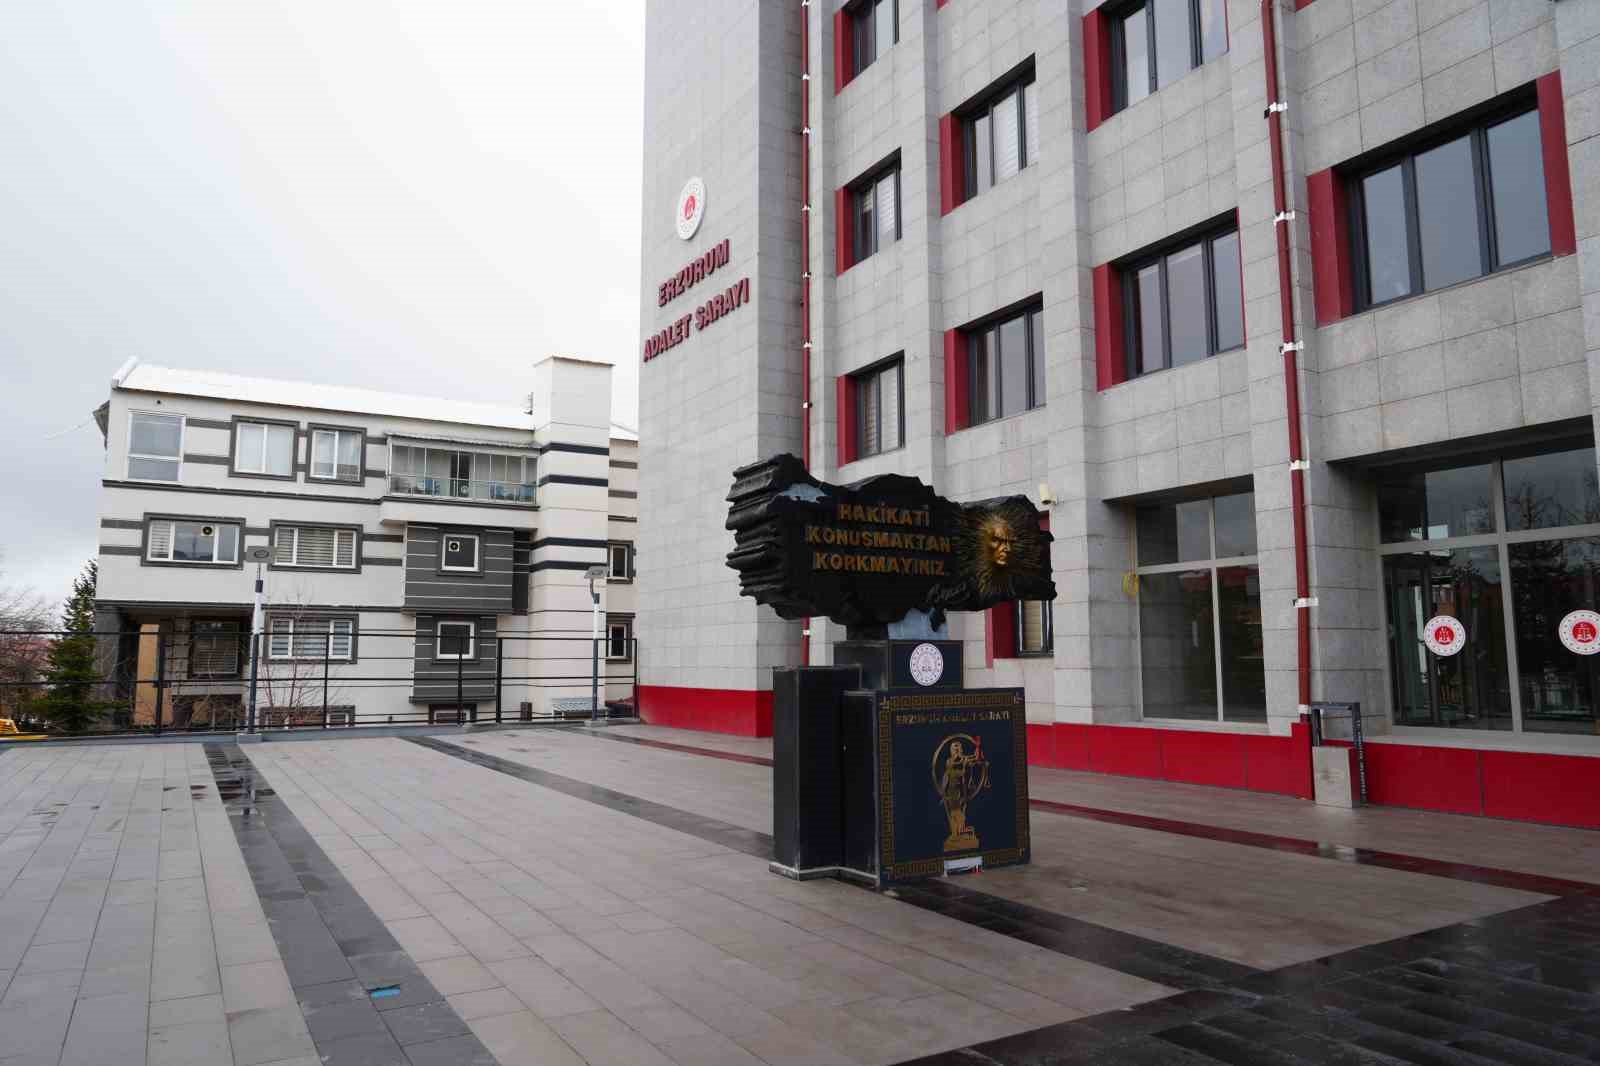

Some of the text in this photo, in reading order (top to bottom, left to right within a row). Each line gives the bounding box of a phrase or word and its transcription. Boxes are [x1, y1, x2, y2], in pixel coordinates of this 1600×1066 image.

[658, 238, 730, 307] ERZURUM
[643, 277, 750, 362] ADALET SARAYI
[812, 551, 945, 576] KORKMAYINIZ
